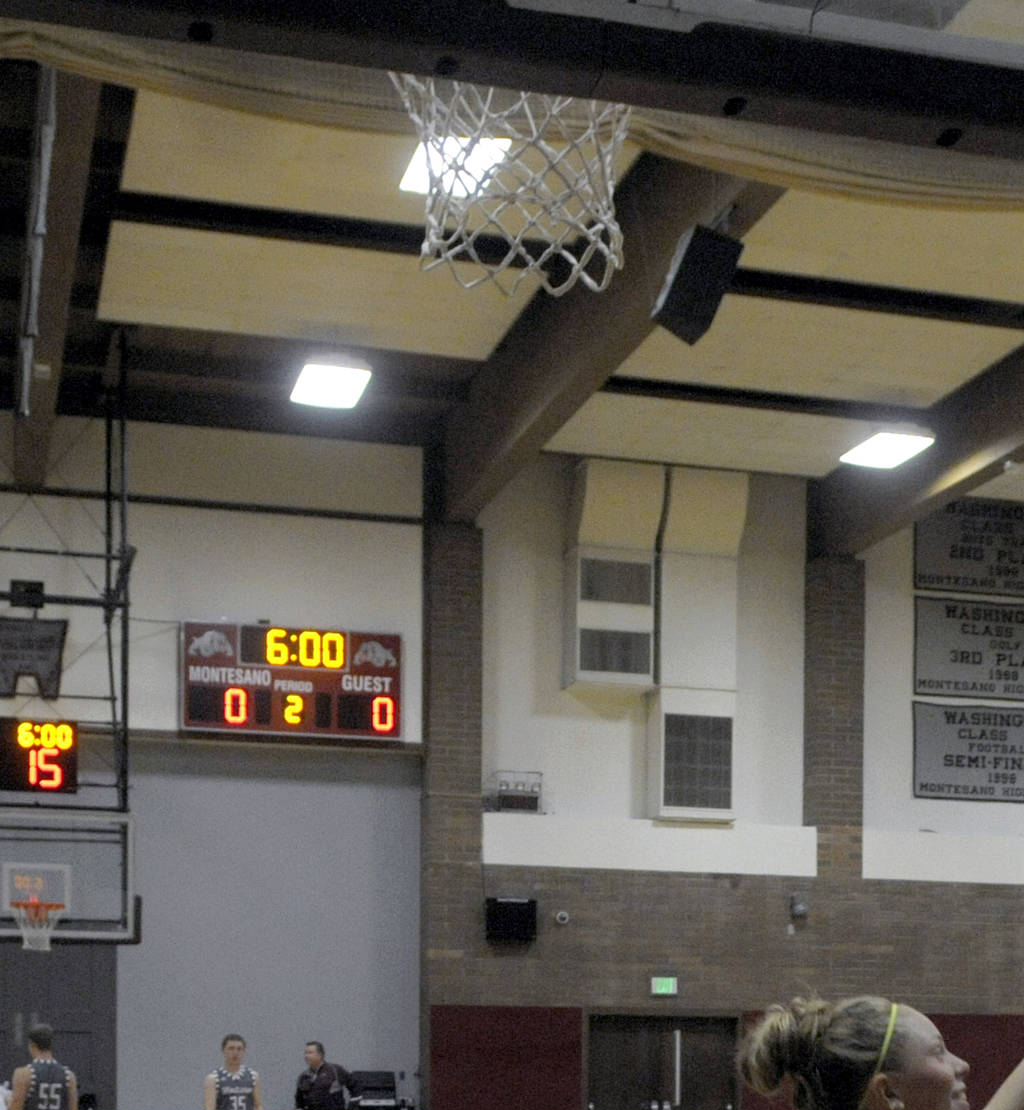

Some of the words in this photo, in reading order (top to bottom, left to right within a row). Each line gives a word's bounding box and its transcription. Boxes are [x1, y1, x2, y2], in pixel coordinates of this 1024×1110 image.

[960, 623, 1014, 638] CLASS
[266, 628, 345, 669] 6:00
[950, 651, 983, 665] 3RD
[188, 665, 271, 686] MONTESANO
[274, 679, 313, 692] PERIOD
[341, 674, 393, 692] GUEST
[917, 679, 996, 693] MONTESANO
[224, 687, 248, 725] 0
[283, 694, 304, 724] 2
[371, 696, 395, 732] 0
[17, 721, 73, 750] 6:00
[957, 728, 1008, 742] CLASS
[29, 748, 62, 789] 15
[919, 782, 995, 796] MONTESANO
[38, 1083, 62, 1110] 55
